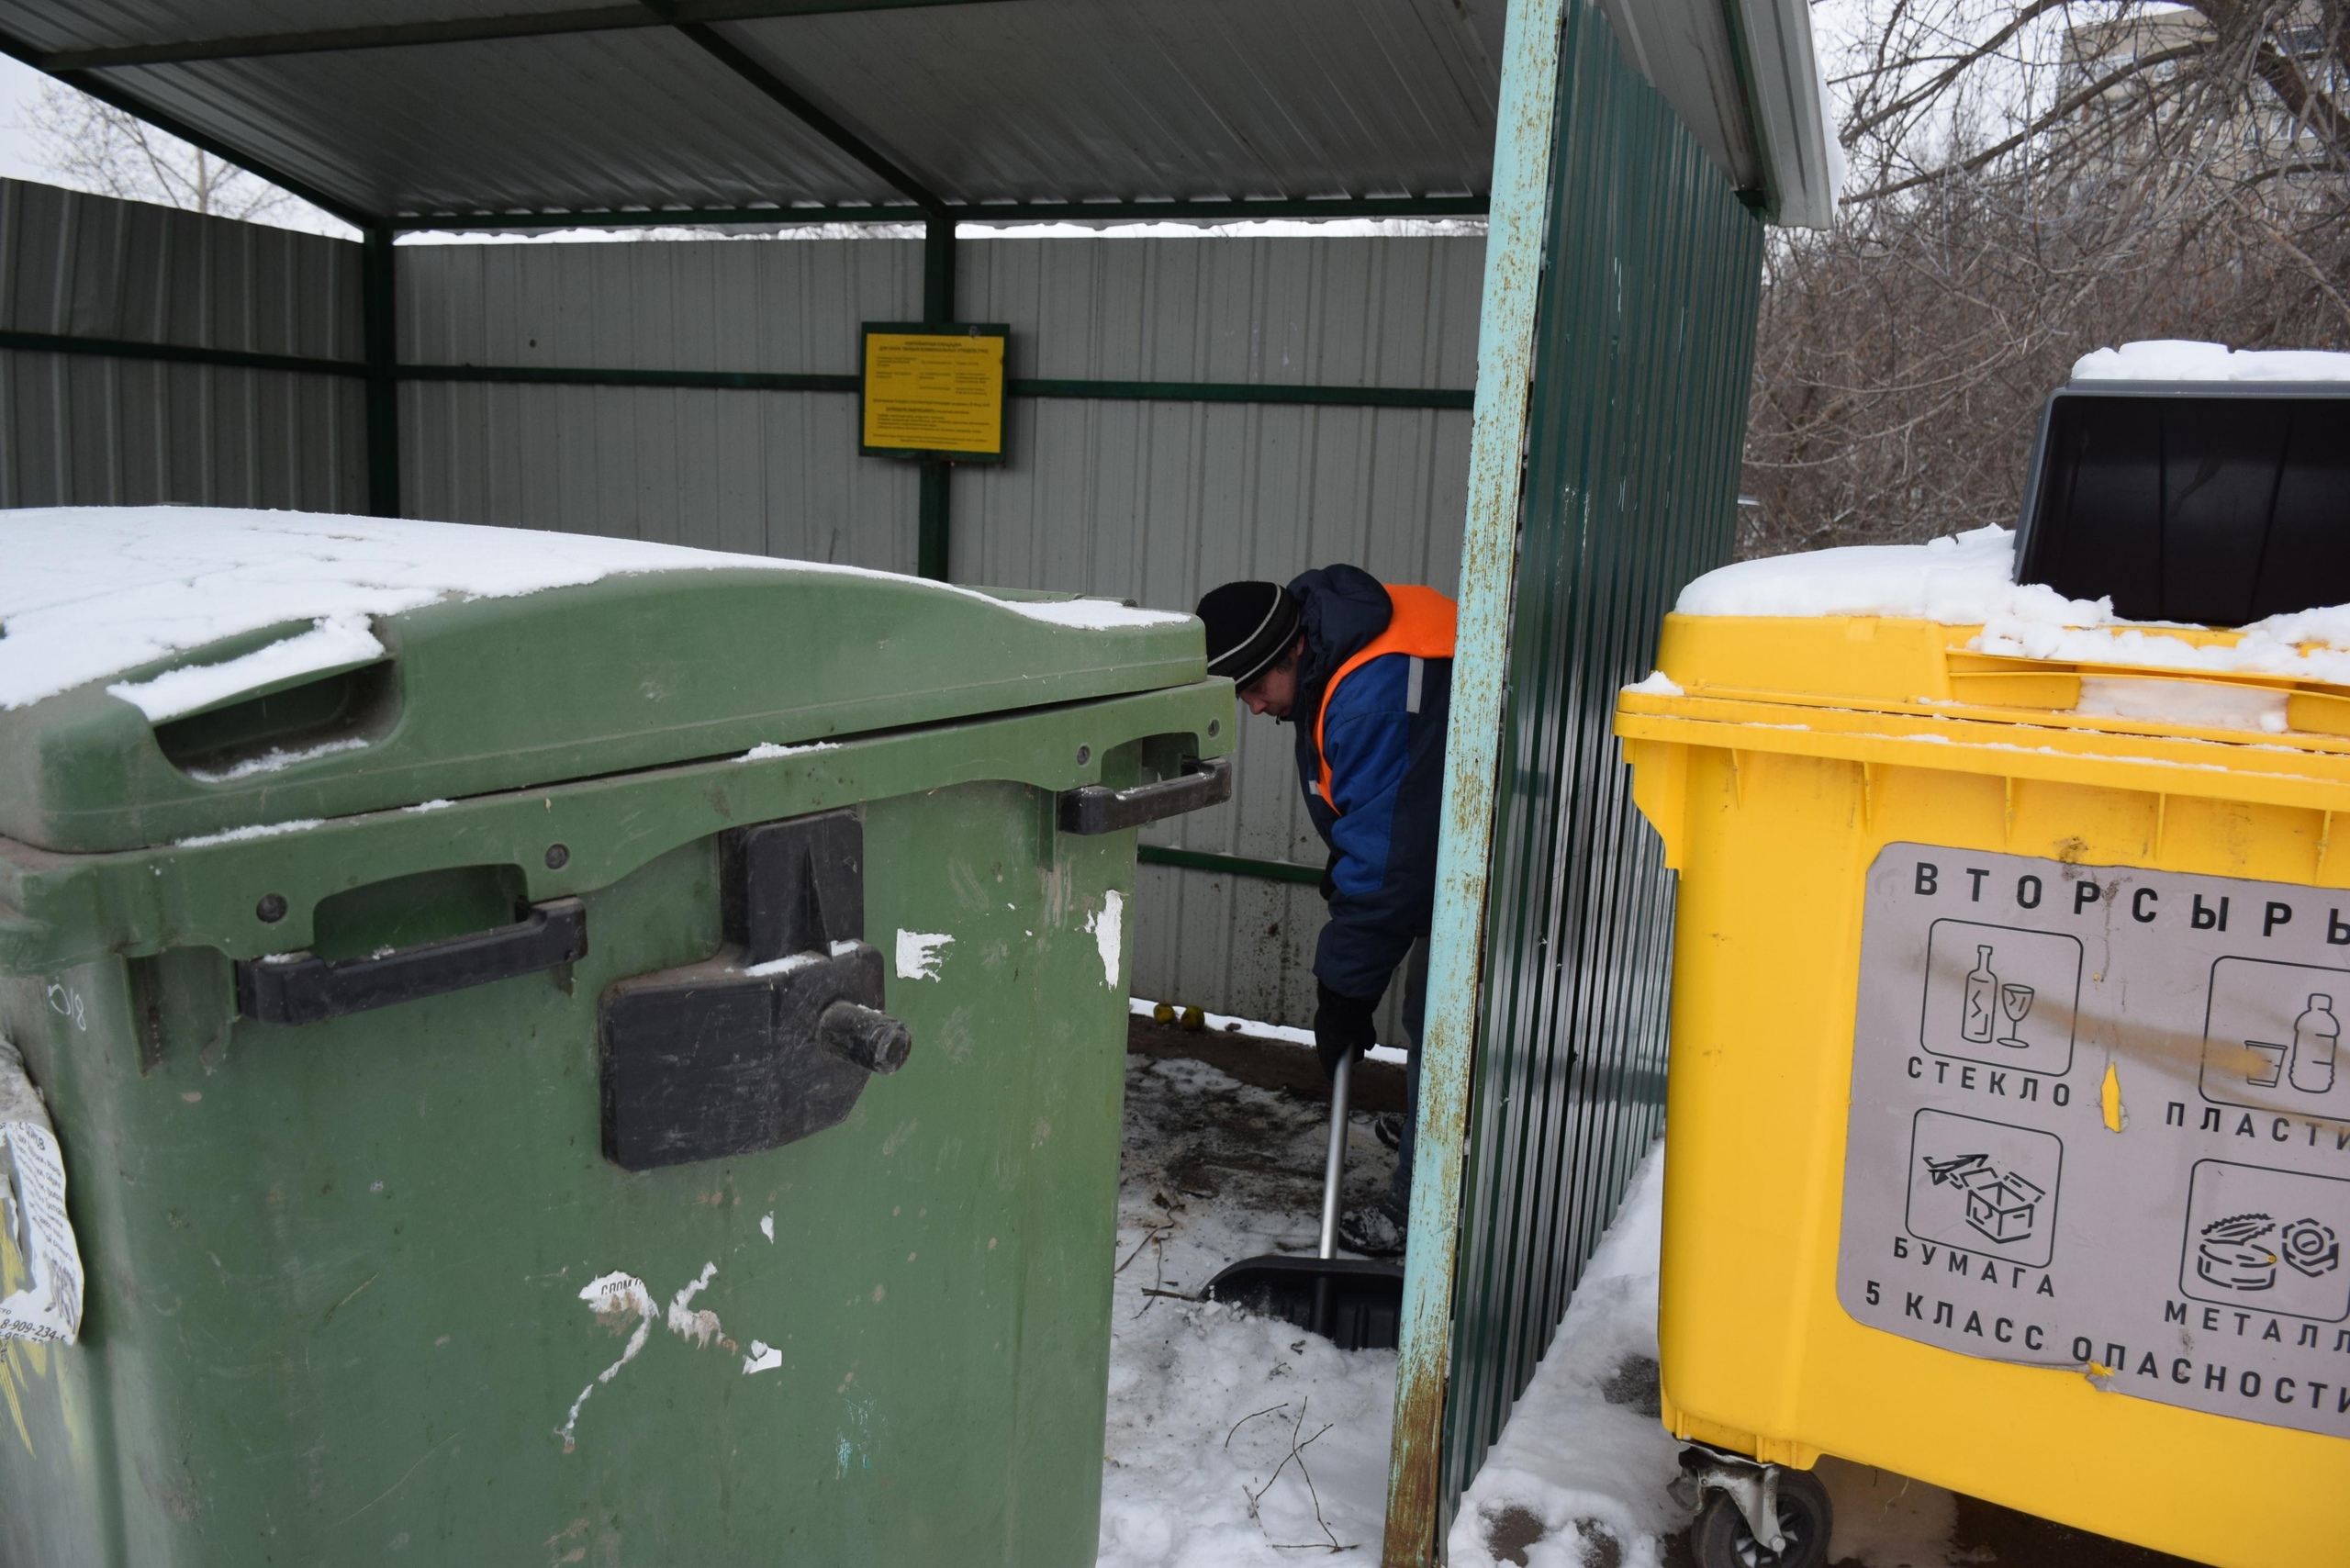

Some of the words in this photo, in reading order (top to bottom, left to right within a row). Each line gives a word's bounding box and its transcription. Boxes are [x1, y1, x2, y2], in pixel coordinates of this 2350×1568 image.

[1914, 862, 2350, 945] ВТОРСЫРЬ
[1907, 1055, 2071, 1107] СТЕКЛО
[1893, 1236, 2056, 1298] БУМАГА
[1865, 1280, 1881, 1306] 5
[1904, 1292, 2044, 1351] КЛАСС
[2164, 1299, 2350, 1354] МЕТАЛЛ
